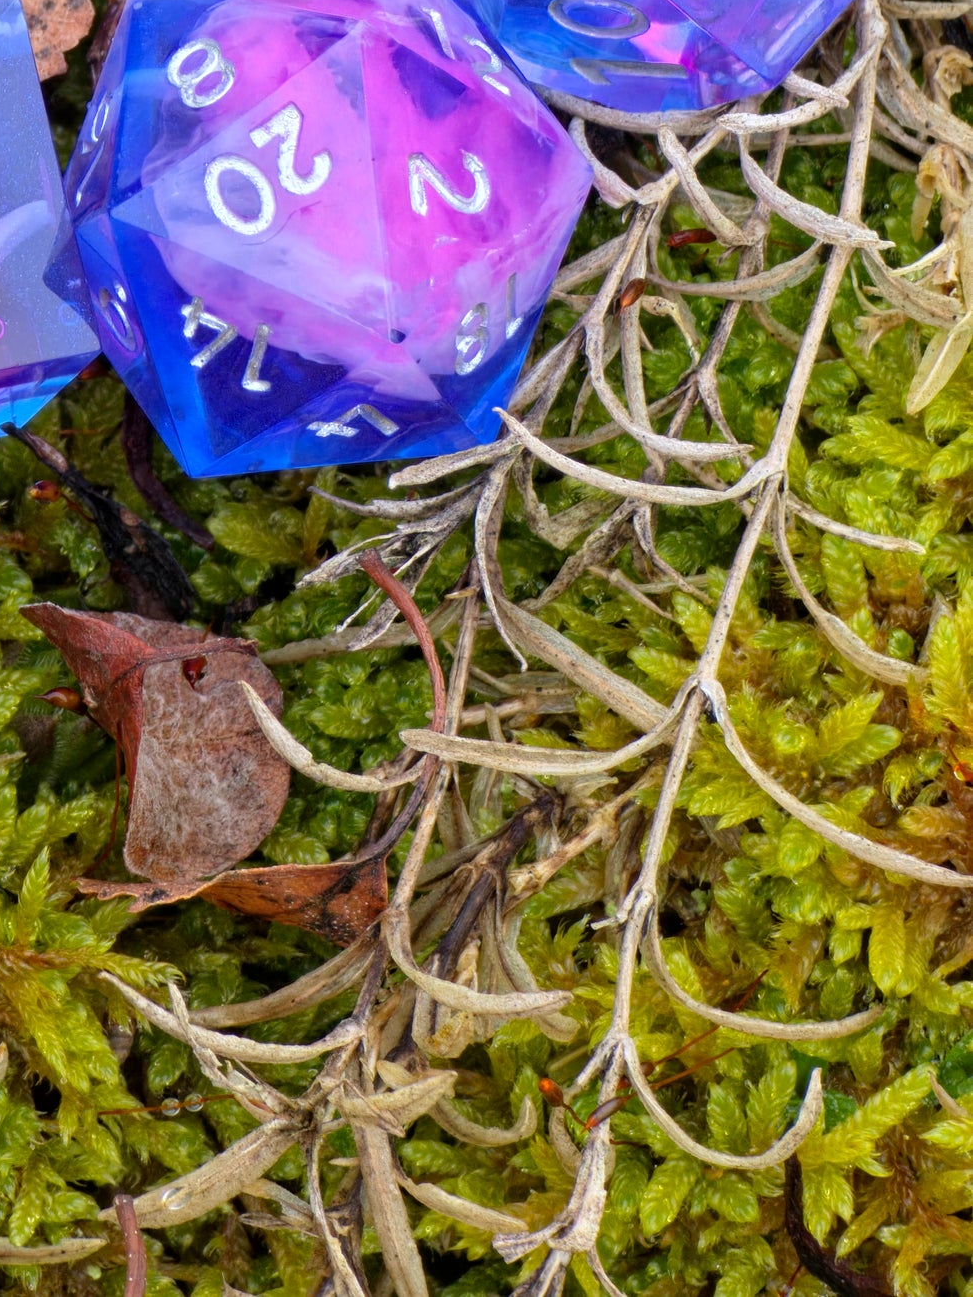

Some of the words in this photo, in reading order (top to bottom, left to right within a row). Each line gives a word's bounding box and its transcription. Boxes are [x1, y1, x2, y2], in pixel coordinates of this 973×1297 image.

[166, 36, 235, 109] 8
[422, 6, 512, 98] 12
[203, 101, 332, 236] 20
[407, 148, 491, 217] 2
[180, 295, 273, 392] 14
[306, 403, 401, 438] 4
